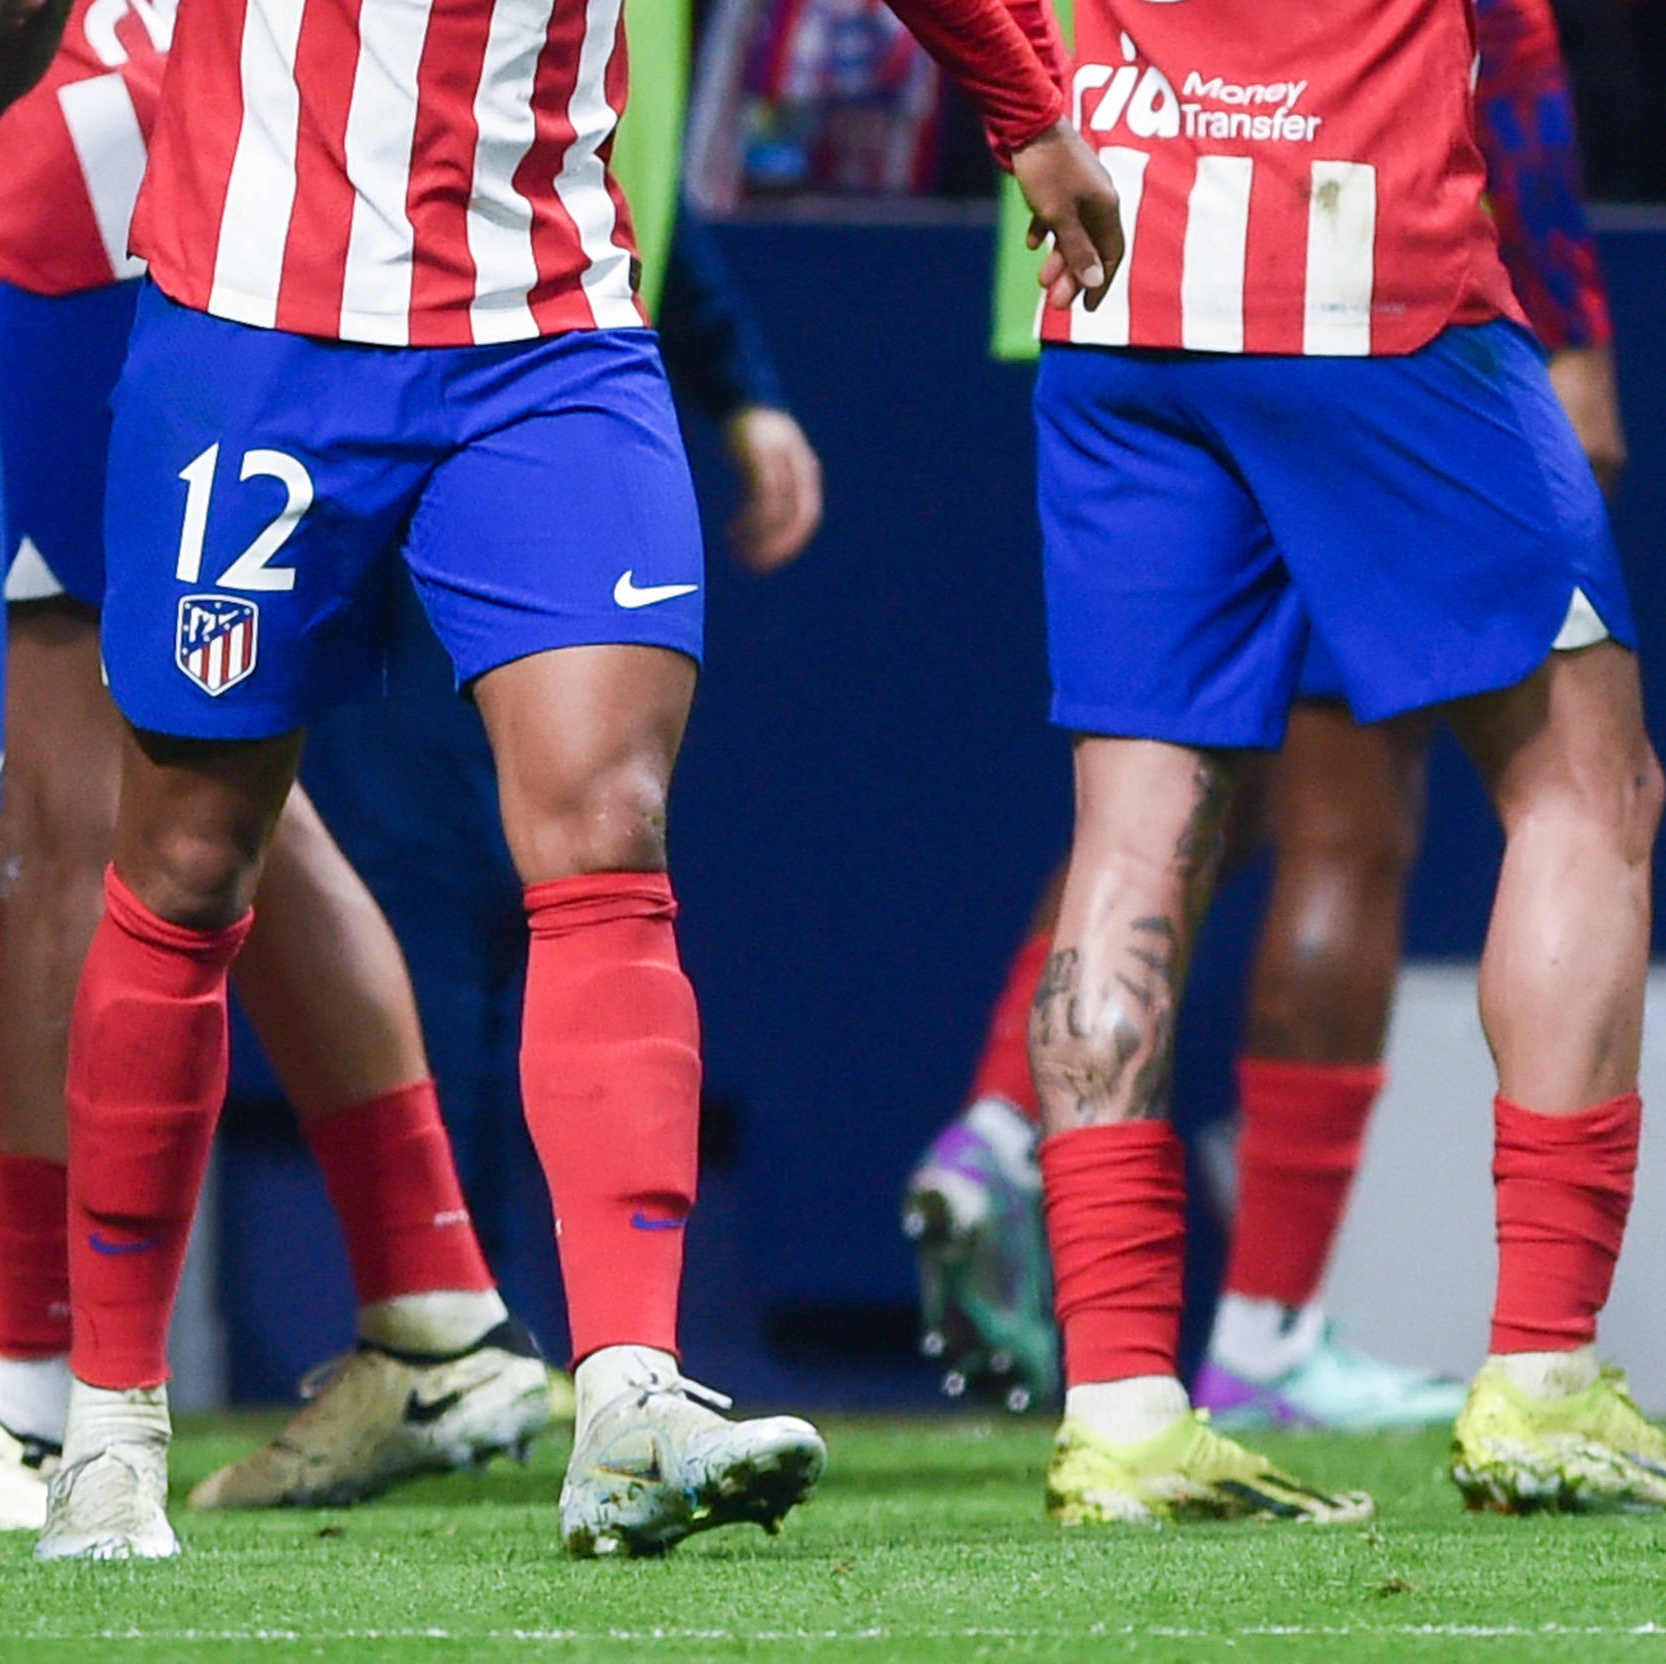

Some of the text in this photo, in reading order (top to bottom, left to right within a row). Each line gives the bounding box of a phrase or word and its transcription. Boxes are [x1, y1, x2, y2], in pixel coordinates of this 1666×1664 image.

[1182, 71, 1308, 108] Money
[1181, 102, 1322, 142] Transfer
[176, 442, 315, 591] 12
